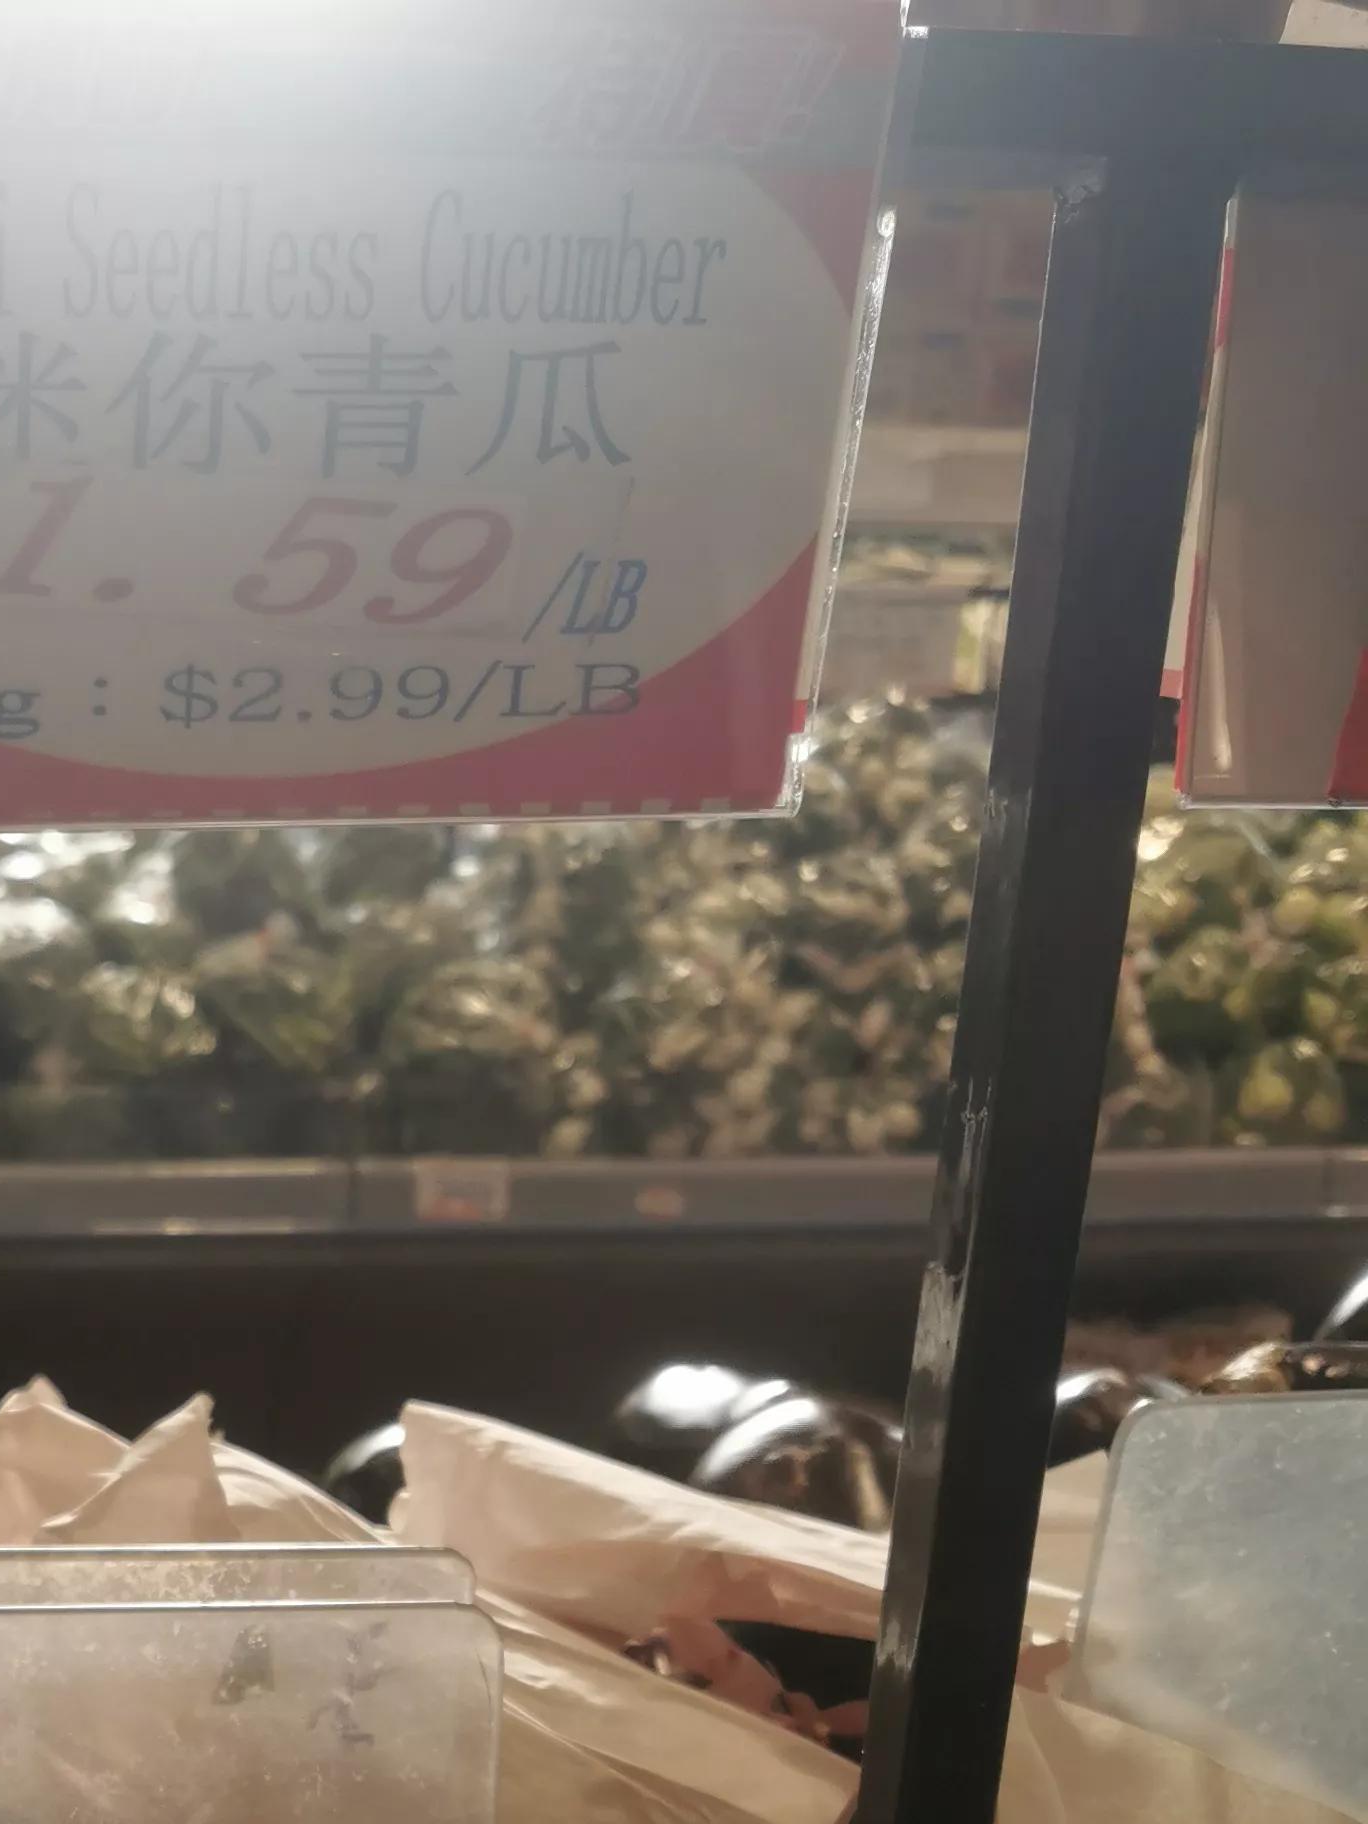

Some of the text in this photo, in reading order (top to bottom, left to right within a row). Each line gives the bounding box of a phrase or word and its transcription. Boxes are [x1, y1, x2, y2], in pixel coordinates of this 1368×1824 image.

[62, 182, 377, 324] Seedless
[419, 186, 728, 327] Cucumber
[159, 659, 644, 728] $2.99/LB
